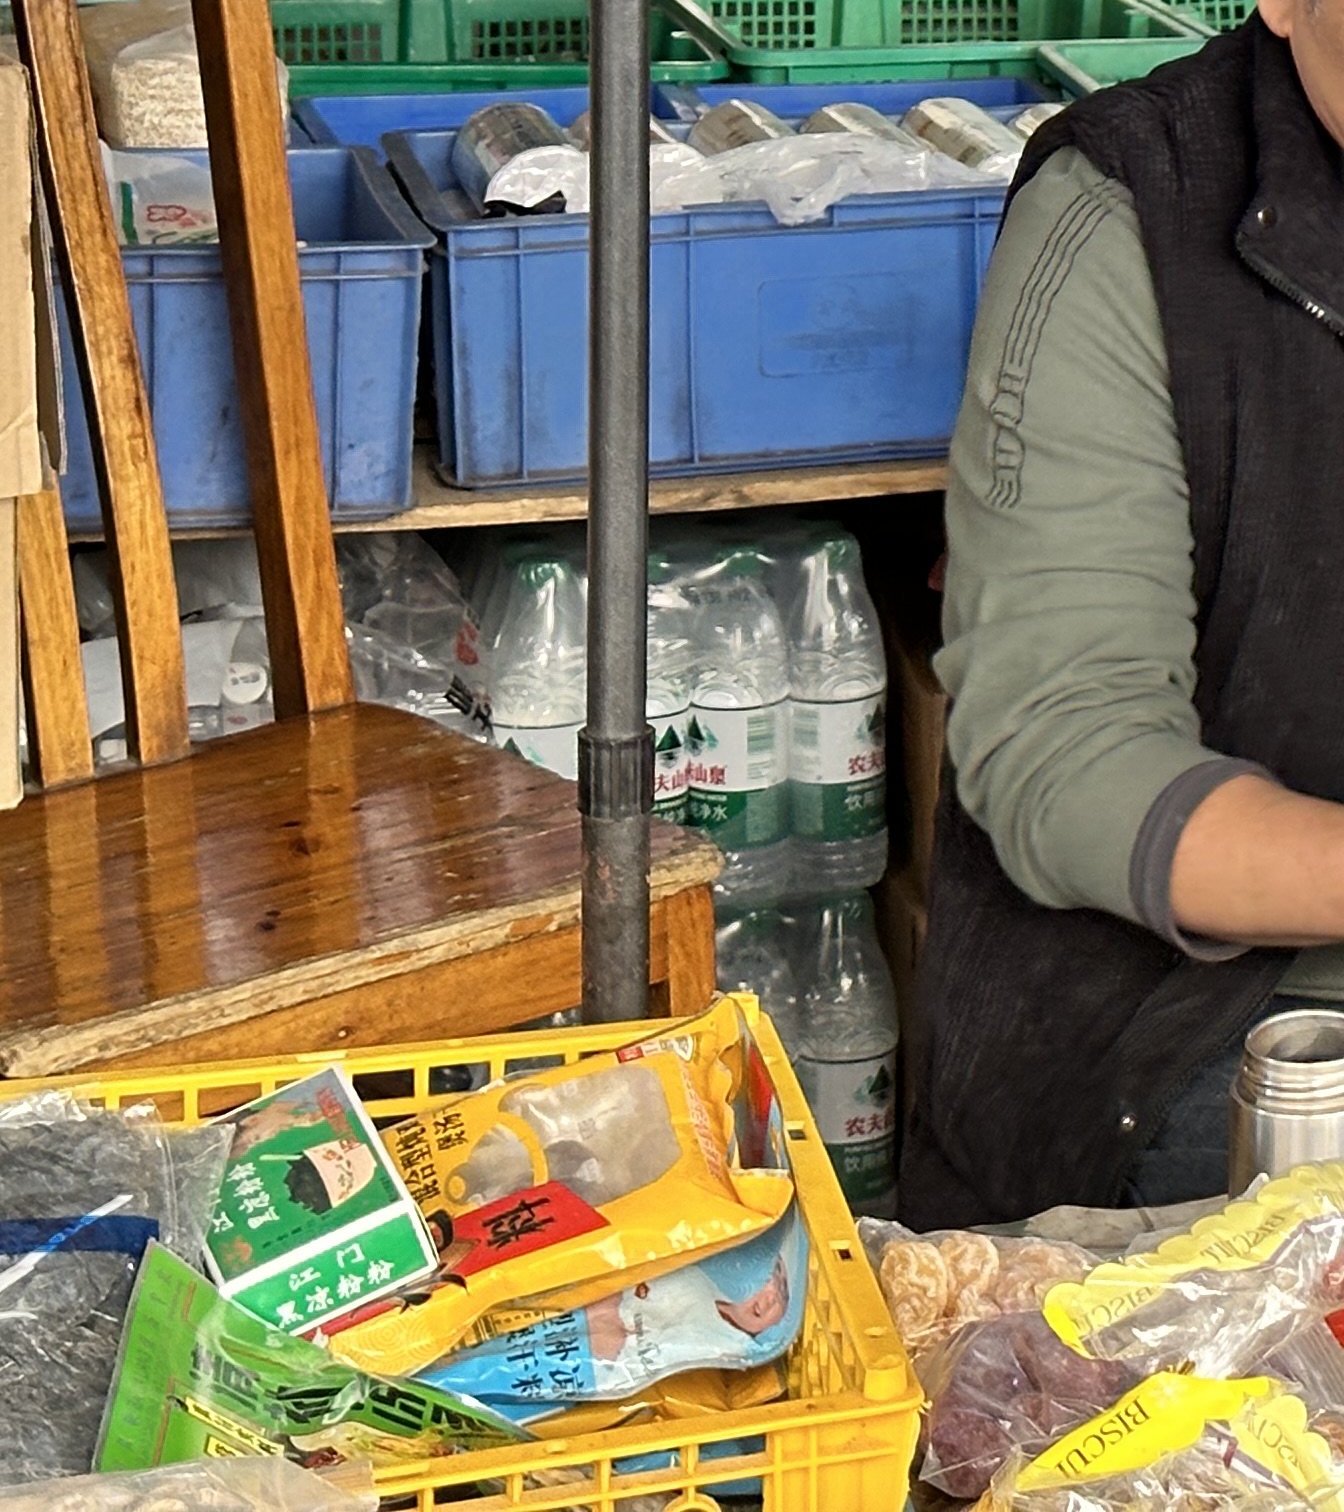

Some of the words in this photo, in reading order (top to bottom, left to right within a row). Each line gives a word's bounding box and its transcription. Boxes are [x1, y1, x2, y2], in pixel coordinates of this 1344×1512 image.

[276, 1258, 396, 1329] 黑凉粉粉
[289, 1242, 366, 1291] 江门
